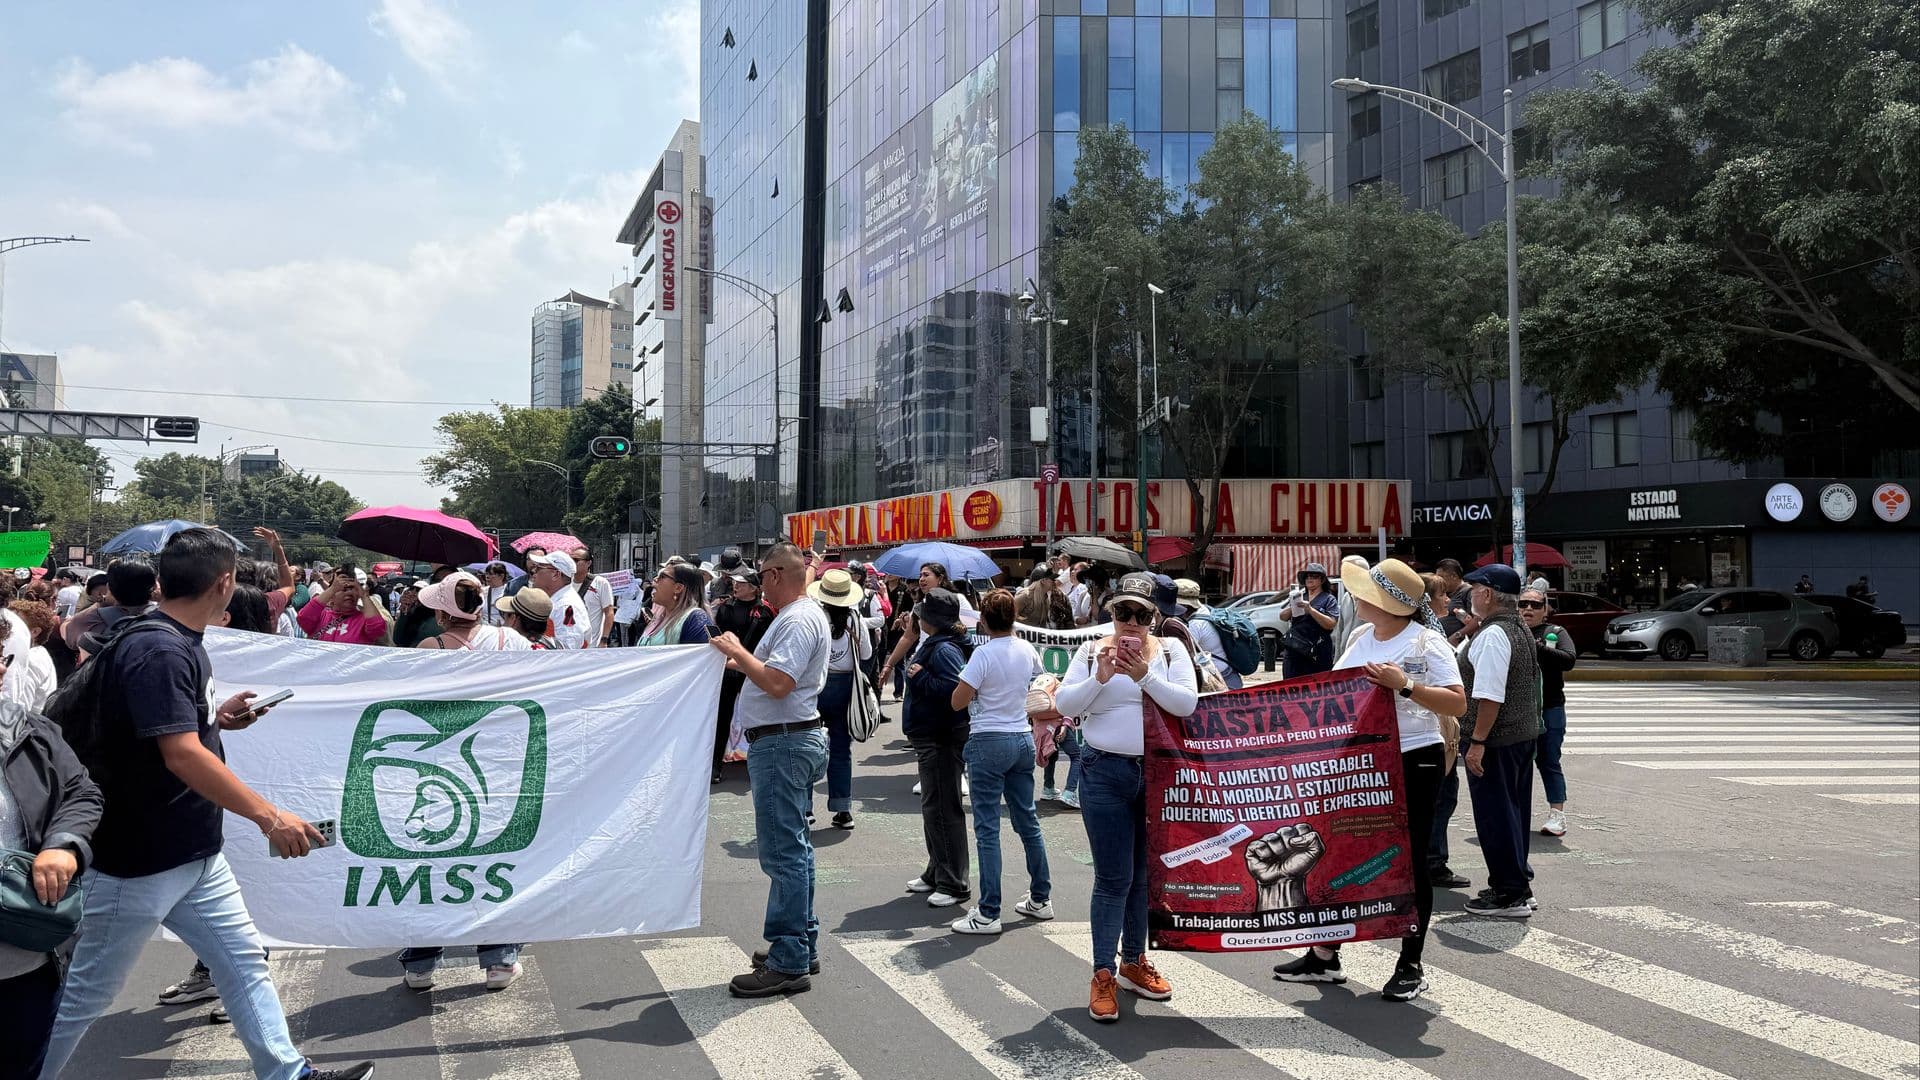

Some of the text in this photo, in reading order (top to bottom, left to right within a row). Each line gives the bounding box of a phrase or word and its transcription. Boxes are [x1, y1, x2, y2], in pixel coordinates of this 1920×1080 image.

[662, 228, 675, 311] URGENCIAS
[1033, 481, 1160, 533] TACOS
[1270, 482, 1403, 534] CHULA
[1630, 489, 1677, 506] ESTADO
[1770, 495, 1793, 503] ARTE
[1773, 502, 1799, 510] MIGA
[845, 505, 873, 545] LA
[877, 492, 956, 543] CHULA
[1411, 504, 1492, 523] RTEMIGA
[1627, 505, 1681, 521] NATURAL
[1254, 677, 1372, 704] TRABAJADOR
[1185, 694, 1358, 740] BASTA YA!
[1184, 724, 1358, 750] PROTESTA PACIFICA PERO FIRME.
[1175, 753, 1374, 787] ¡NO AL AUMENTO MISERABLE!
[1164, 772, 1390, 805] ¡NO A LA MORDAZA ESTATUTARIA!
[1161, 790, 1394, 823] ¡QUEREMOS LIBERTAD DE EXPRESION!
[1164, 827, 1247, 864] Dignidad laboral para
[1203, 849, 1228, 862] todos
[342, 862, 517, 907] IMSS
[1171, 901, 1396, 930] Trabajadores IMSS en pie de lucha.
[1227, 928, 1350, 946] Querétaro Convoca
